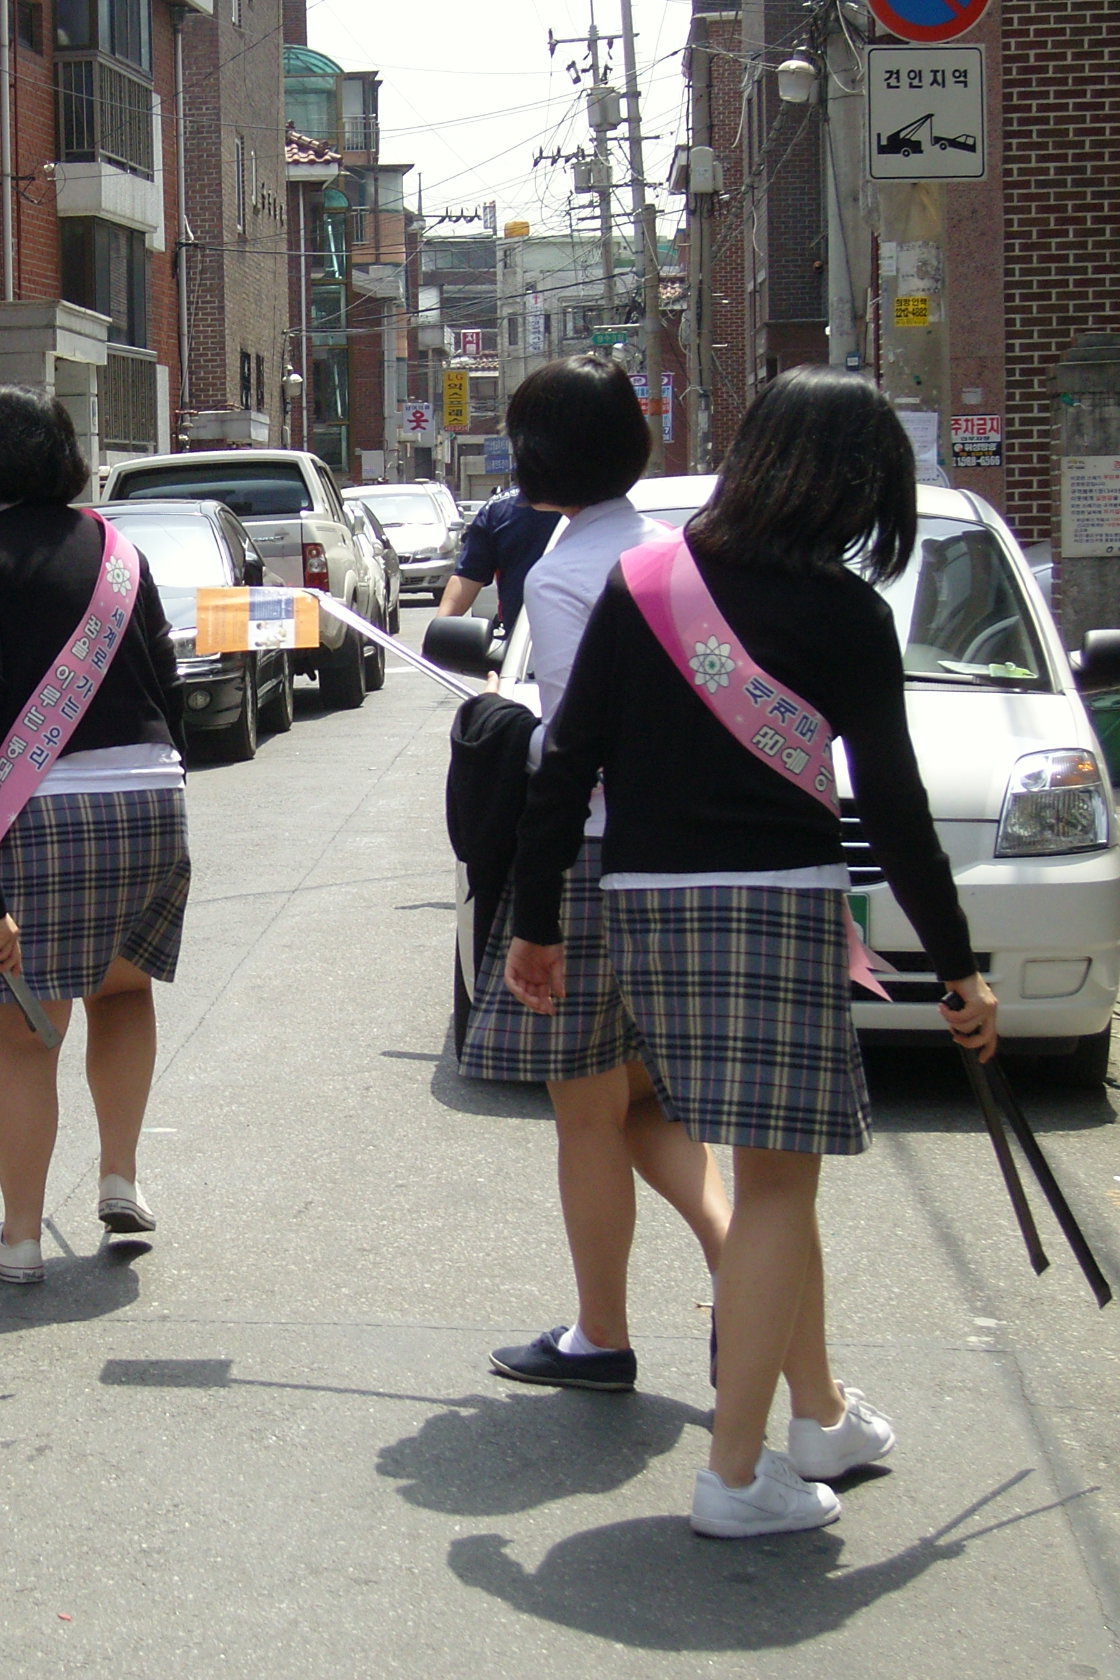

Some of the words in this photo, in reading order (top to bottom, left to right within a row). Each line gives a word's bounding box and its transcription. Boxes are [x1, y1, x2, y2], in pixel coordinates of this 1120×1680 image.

[883, 68, 969, 90] 견인지역
[447, 373, 464, 381] LG
[406, 409, 430, 431] 옷
[447, 383, 463, 425] 익스프레스
[951, 417, 1000, 436] 주차금지
[71, 614, 103, 662] 꿈을
[90, 606, 126, 672] 세계로
[23, 664, 76, 732] 이루는
[59, 674, 95, 721] 가는
[744, 677, 819, 743] 세계로
[27, 726, 61, 771] 우리
[751, 725, 810, 775] 꿈을
